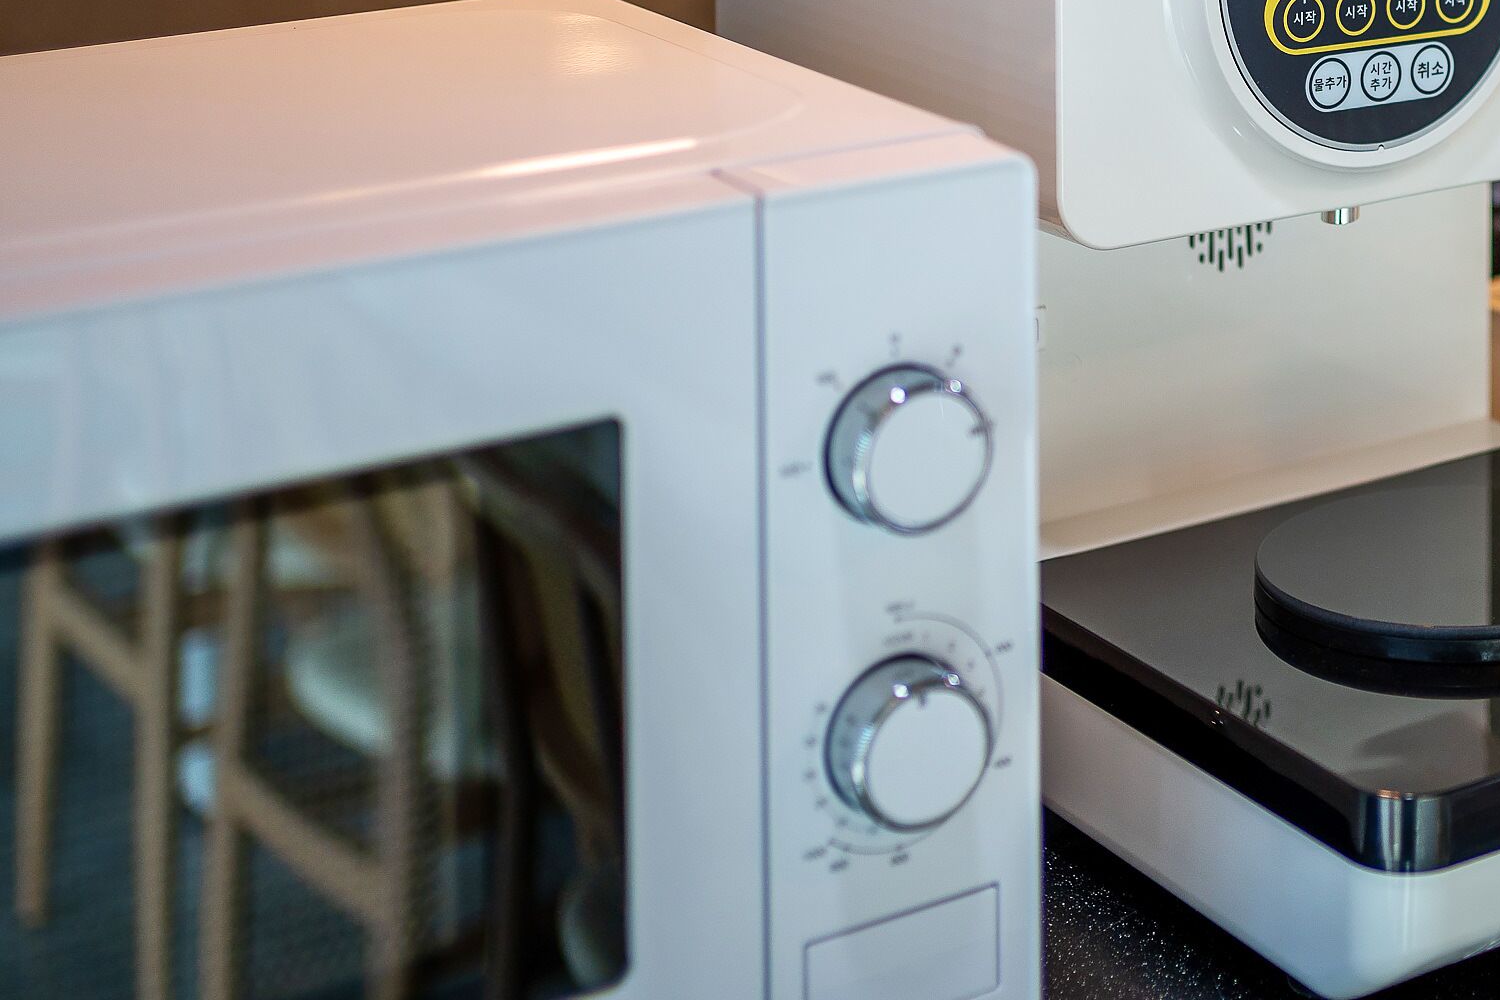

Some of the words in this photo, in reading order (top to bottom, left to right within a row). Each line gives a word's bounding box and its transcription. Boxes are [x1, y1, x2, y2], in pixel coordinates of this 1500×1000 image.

[1293, 11, 1317, 26] 시작
[1345, 4, 1368, 19] 시작
[1370, 61, 1393, 75] 시간
[1417, 61, 1444, 79] 취소
[1313, 75, 1346, 92] 물추가
[1370, 77, 1393, 91] 추가
